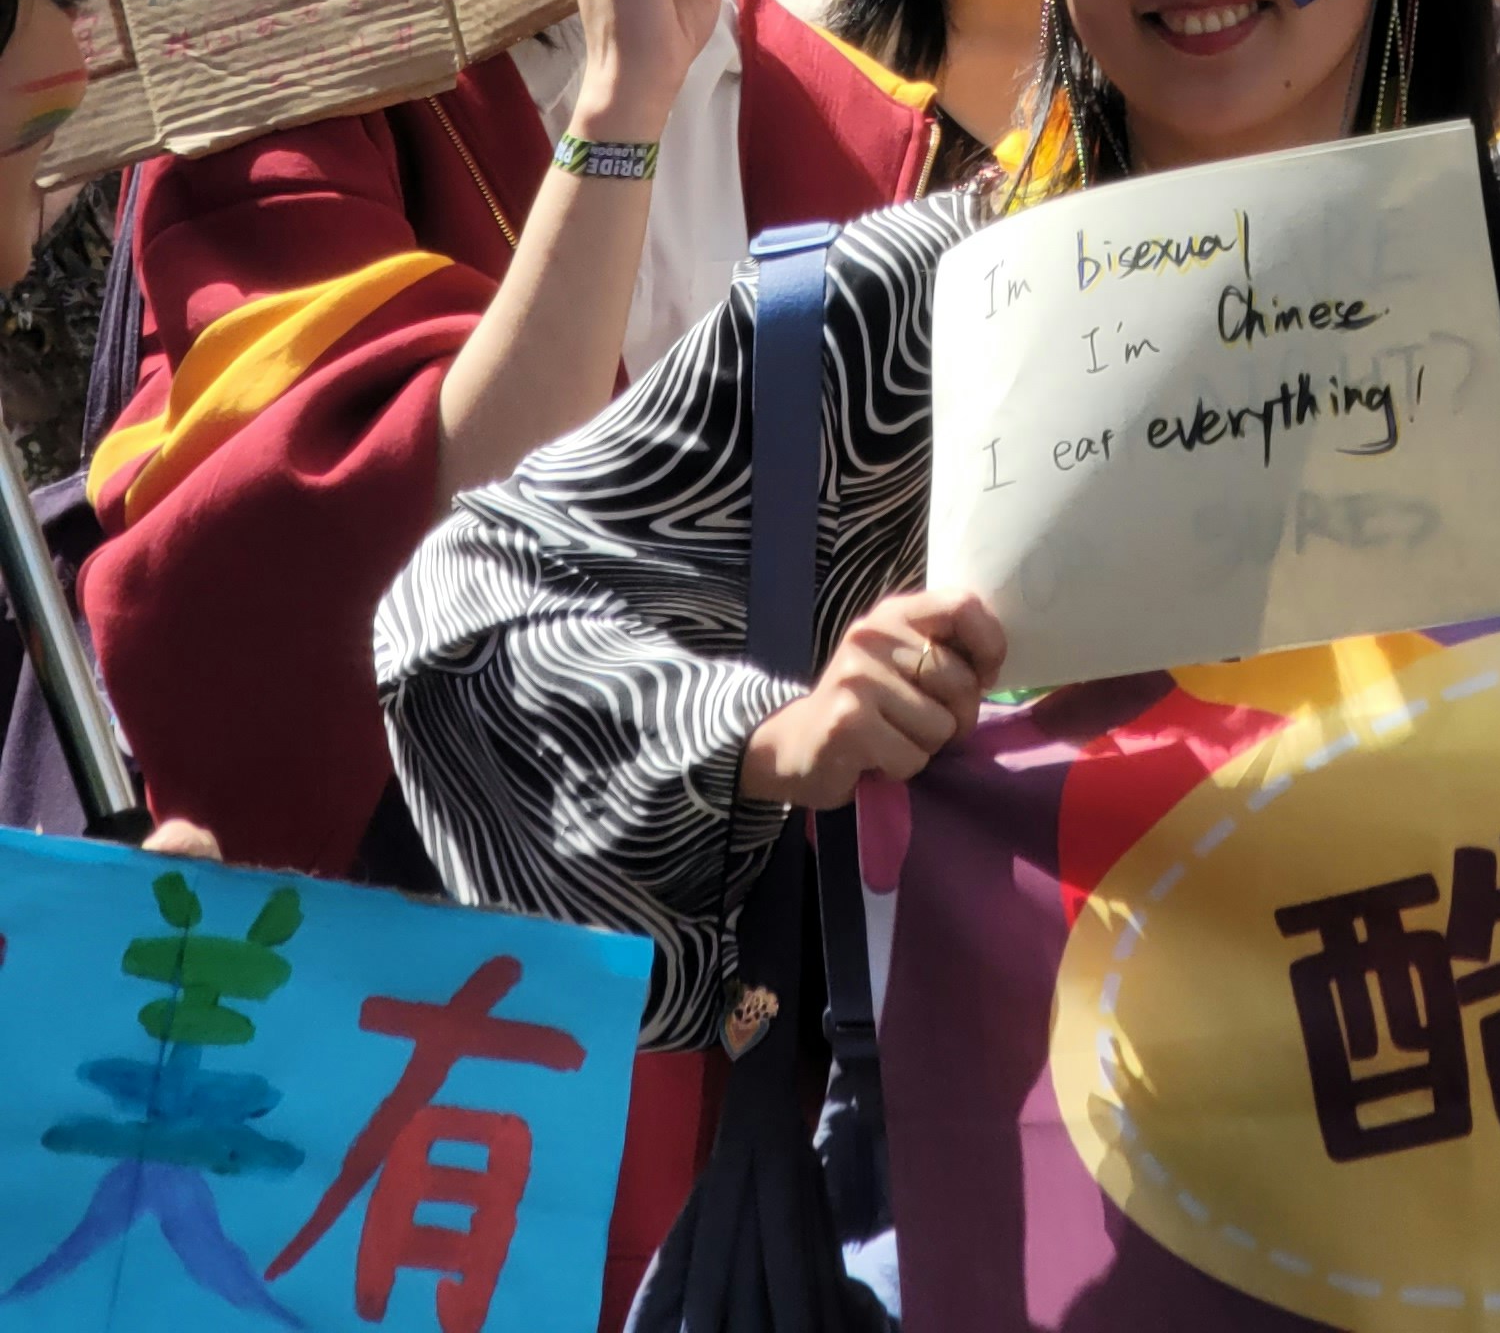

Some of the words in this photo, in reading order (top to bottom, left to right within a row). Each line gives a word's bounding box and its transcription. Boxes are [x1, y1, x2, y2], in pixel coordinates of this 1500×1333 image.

[983, 258, 1032, 320] I'm
[1076, 209, 1251, 291] bisexual
[1080, 321, 1160, 374] I'm
[982, 436, 1016, 493] I
[1145, 363, 1426, 469] everything!
